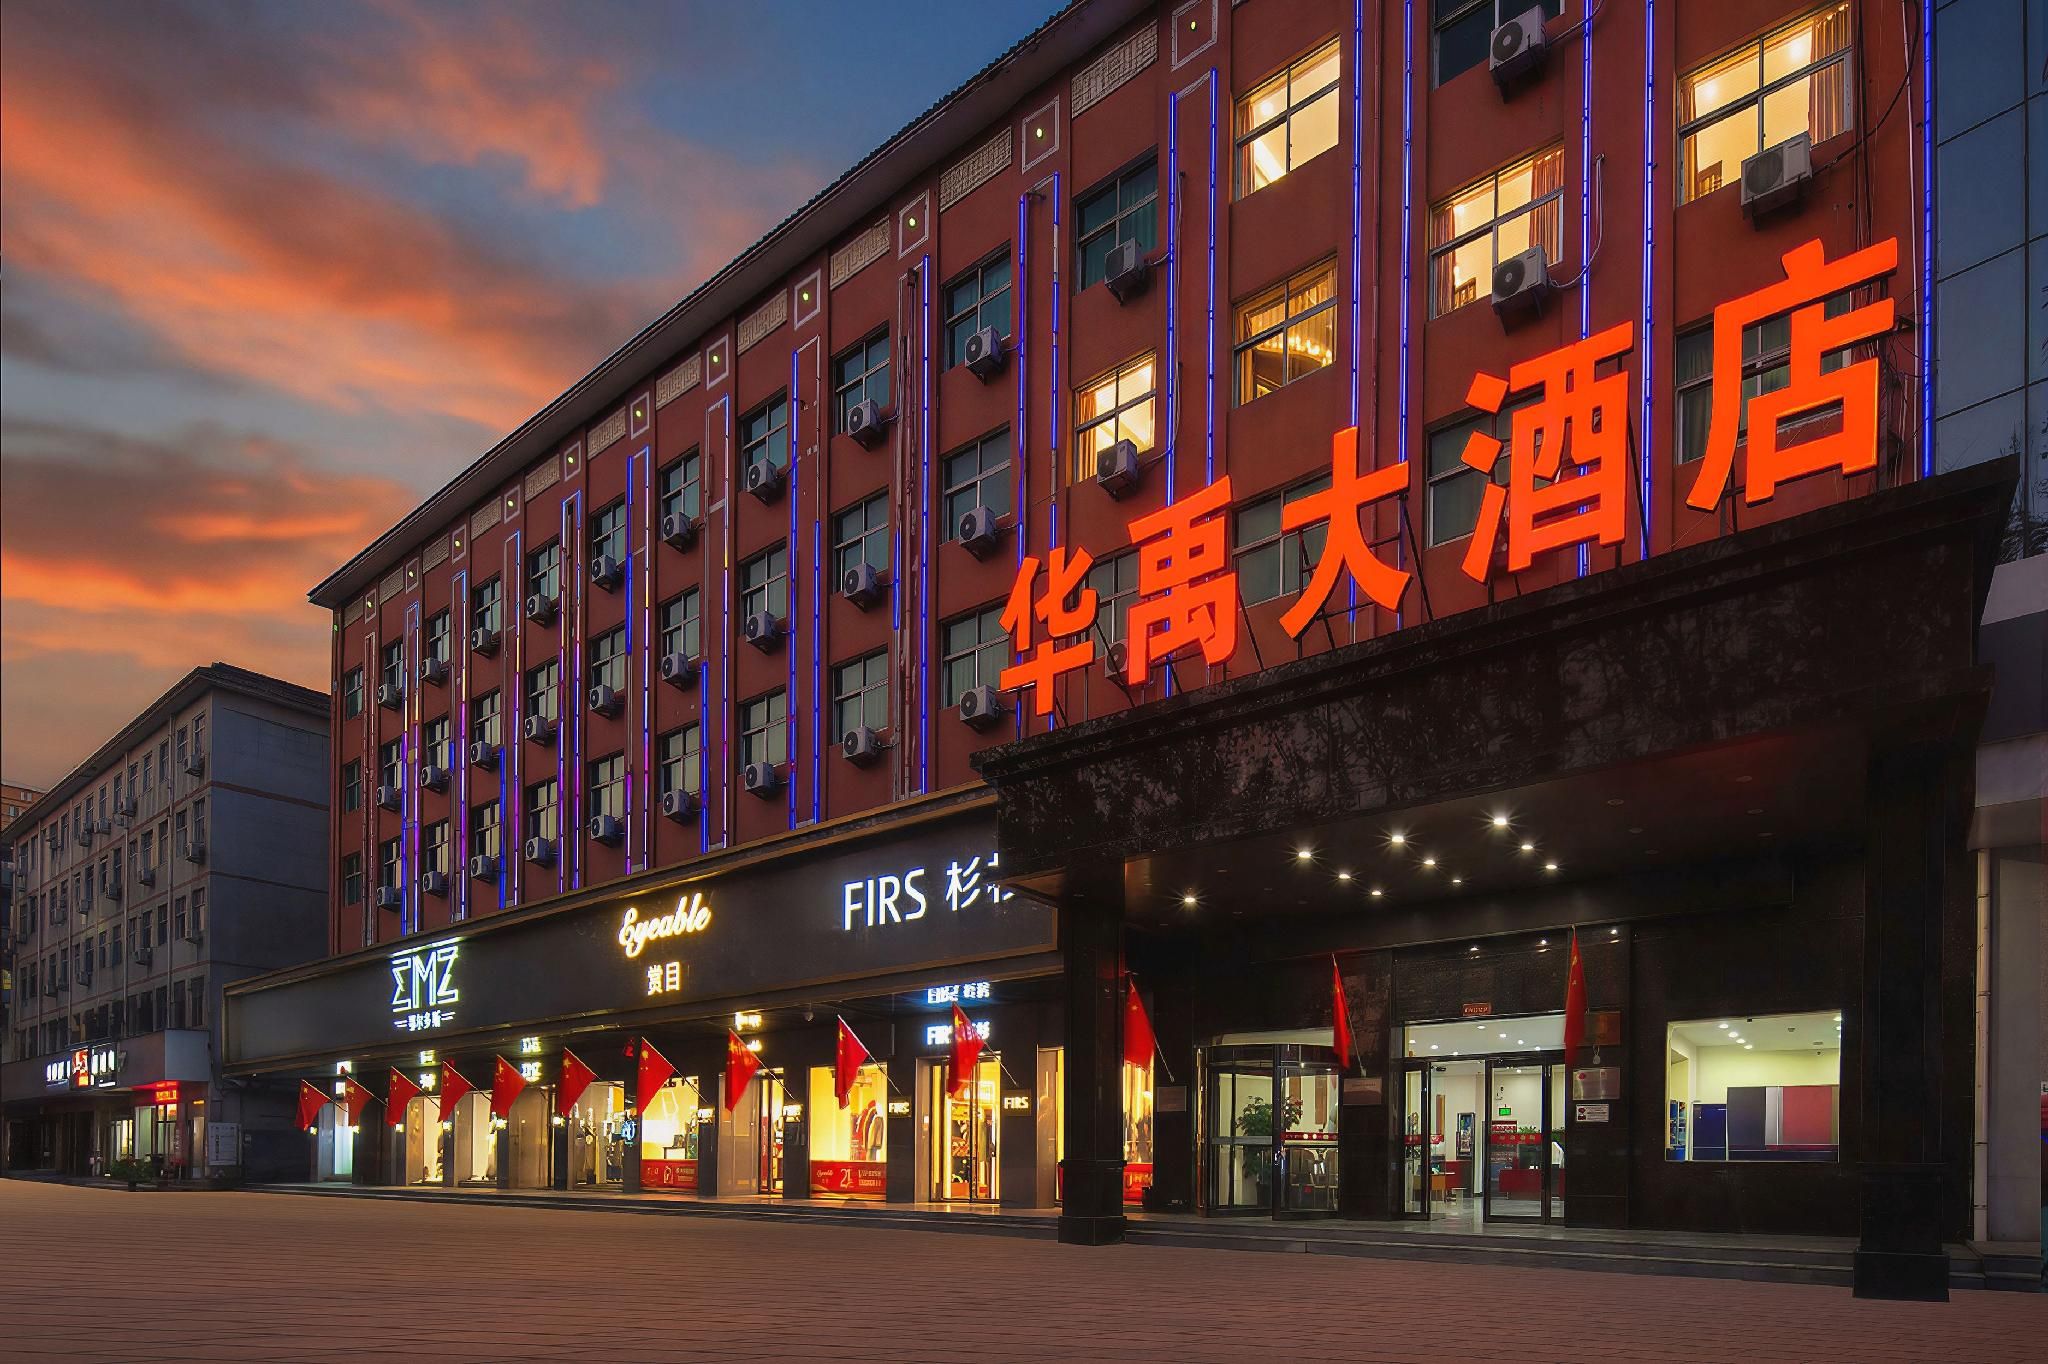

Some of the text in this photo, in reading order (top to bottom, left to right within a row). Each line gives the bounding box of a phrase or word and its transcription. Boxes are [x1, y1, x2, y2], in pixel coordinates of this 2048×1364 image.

[1000, 238, 1898, 715] 华禹大酒店
[618, 892, 712, 958] Eyeable
[842, 868, 927, 931] FIRS
[647, 961, 681, 996] 赏目
